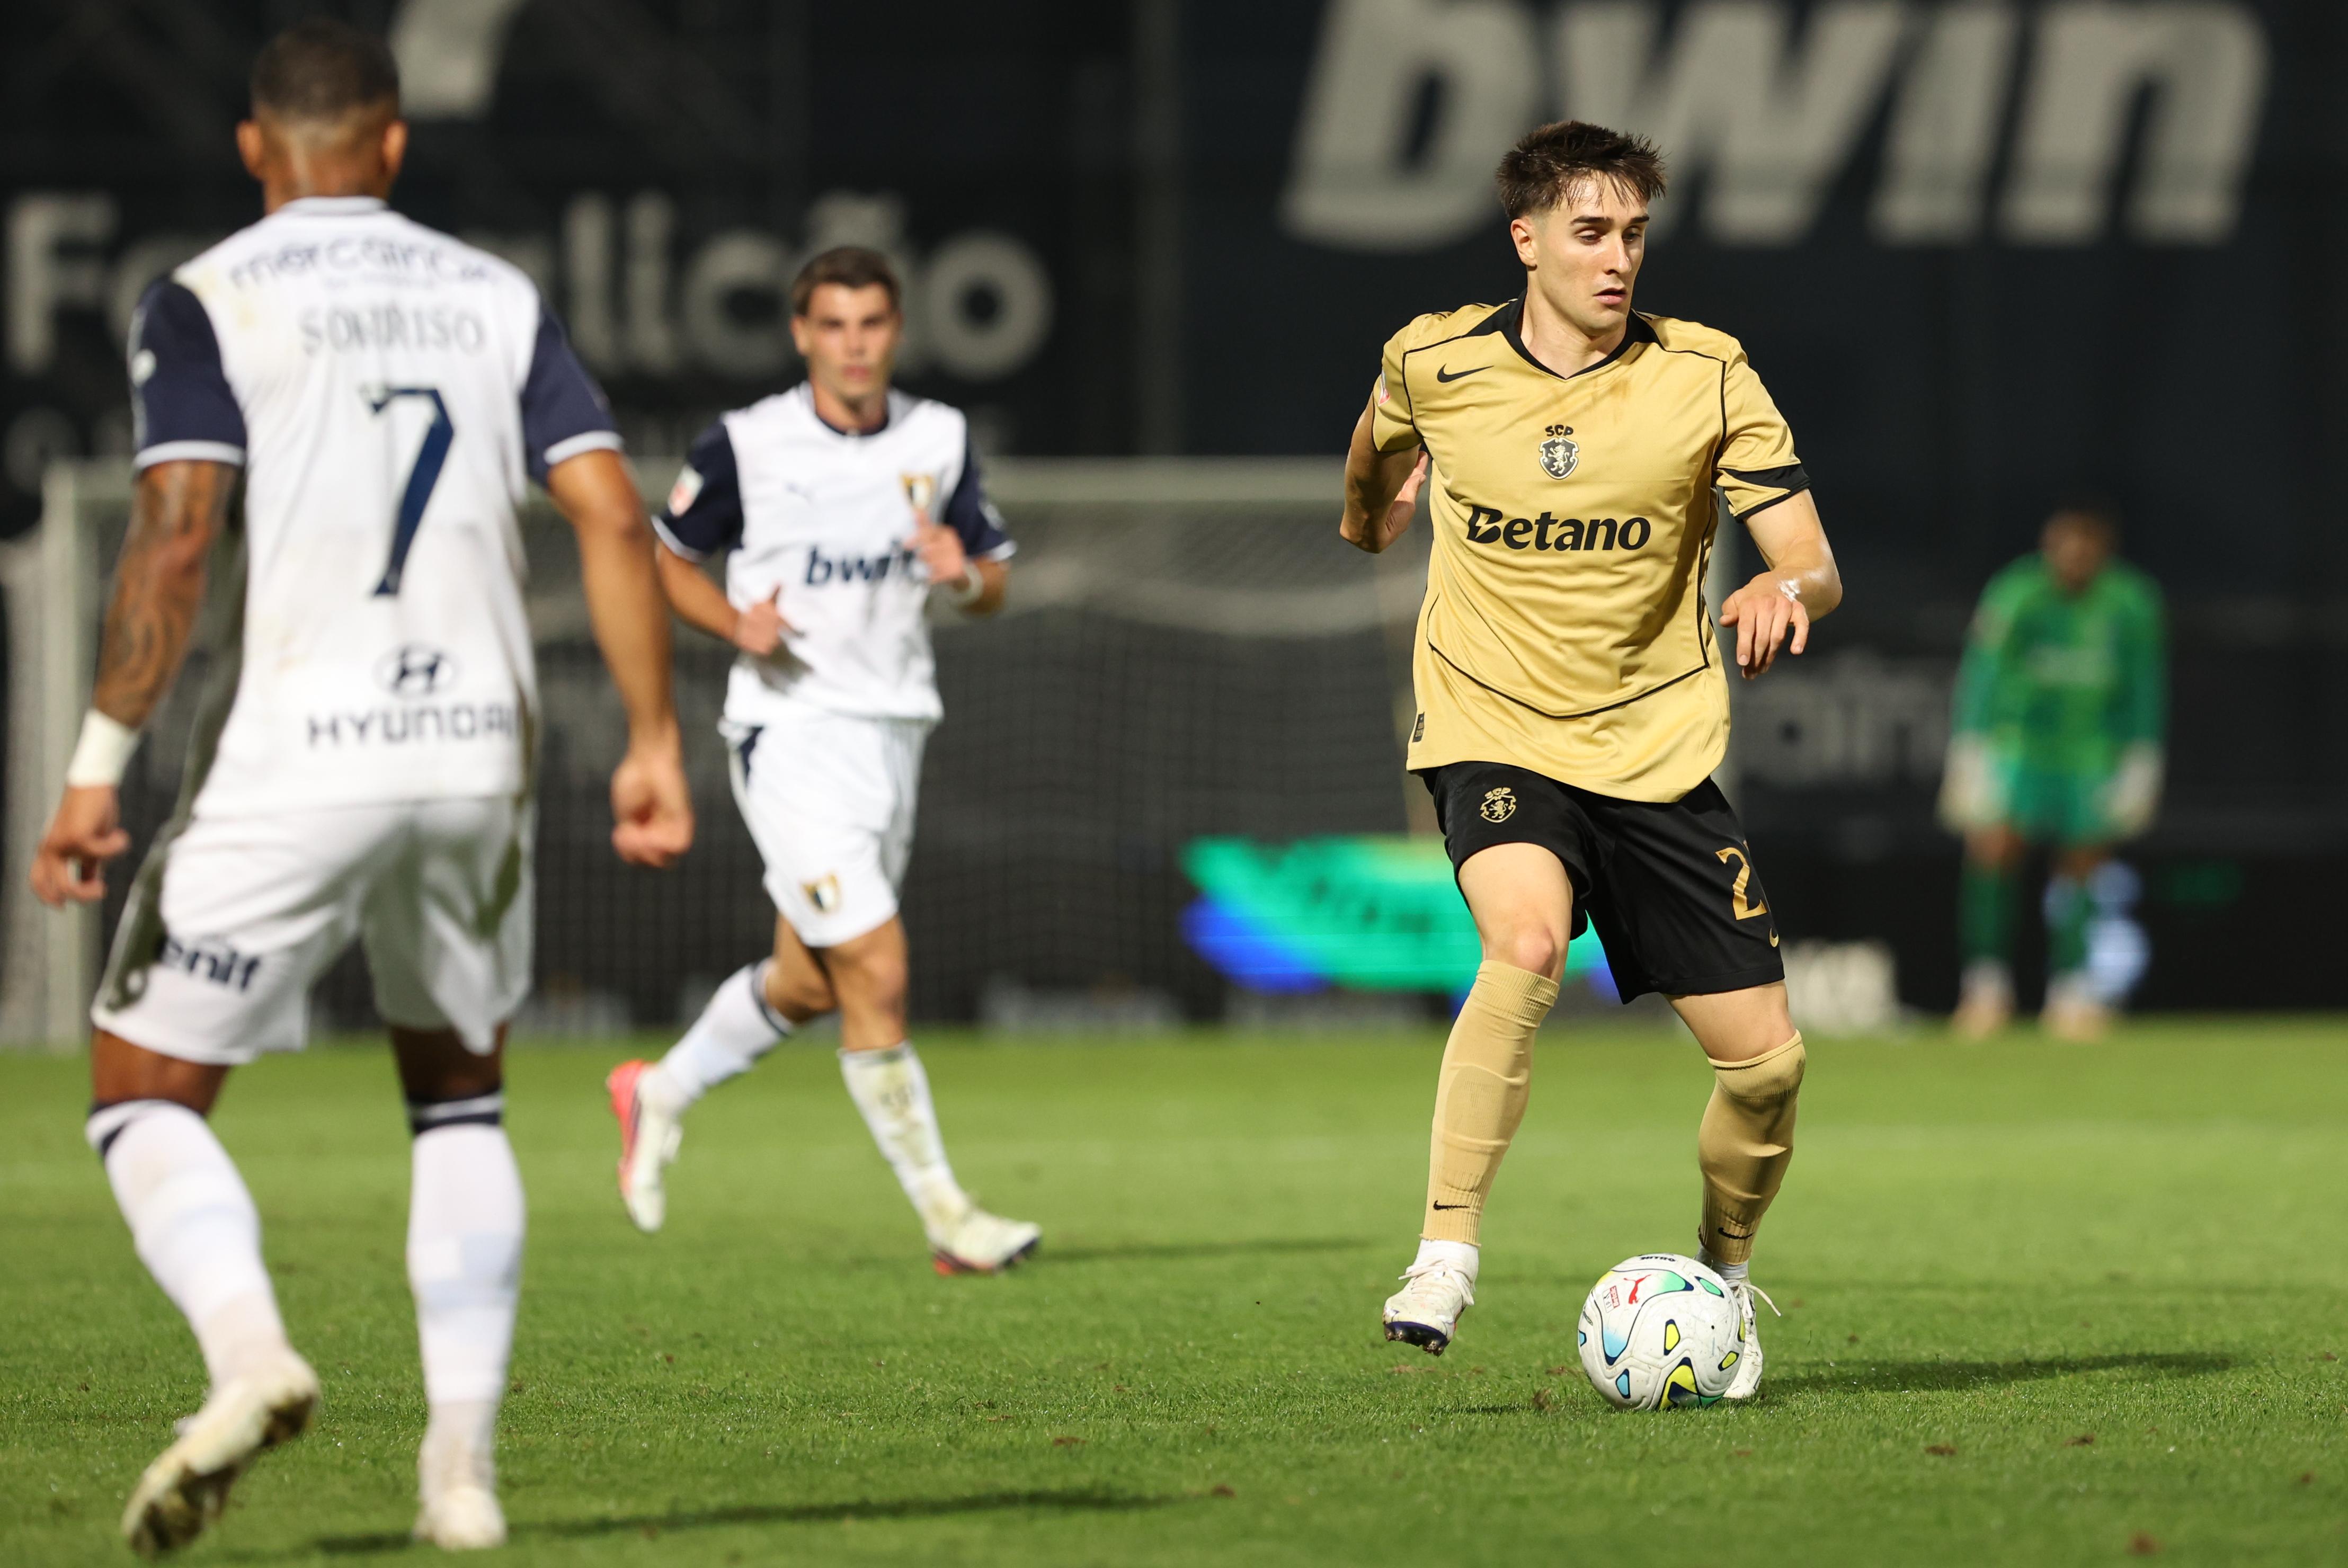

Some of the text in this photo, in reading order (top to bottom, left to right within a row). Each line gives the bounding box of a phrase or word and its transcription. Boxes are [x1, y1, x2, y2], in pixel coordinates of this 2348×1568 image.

[1545, 424, 1573, 436] SCP
[358, 384, 456, 598] 7
[1466, 505, 1651, 551] Betano
[1484, 787, 1511, 799] SCP
[1715, 839, 1767, 920] 2
